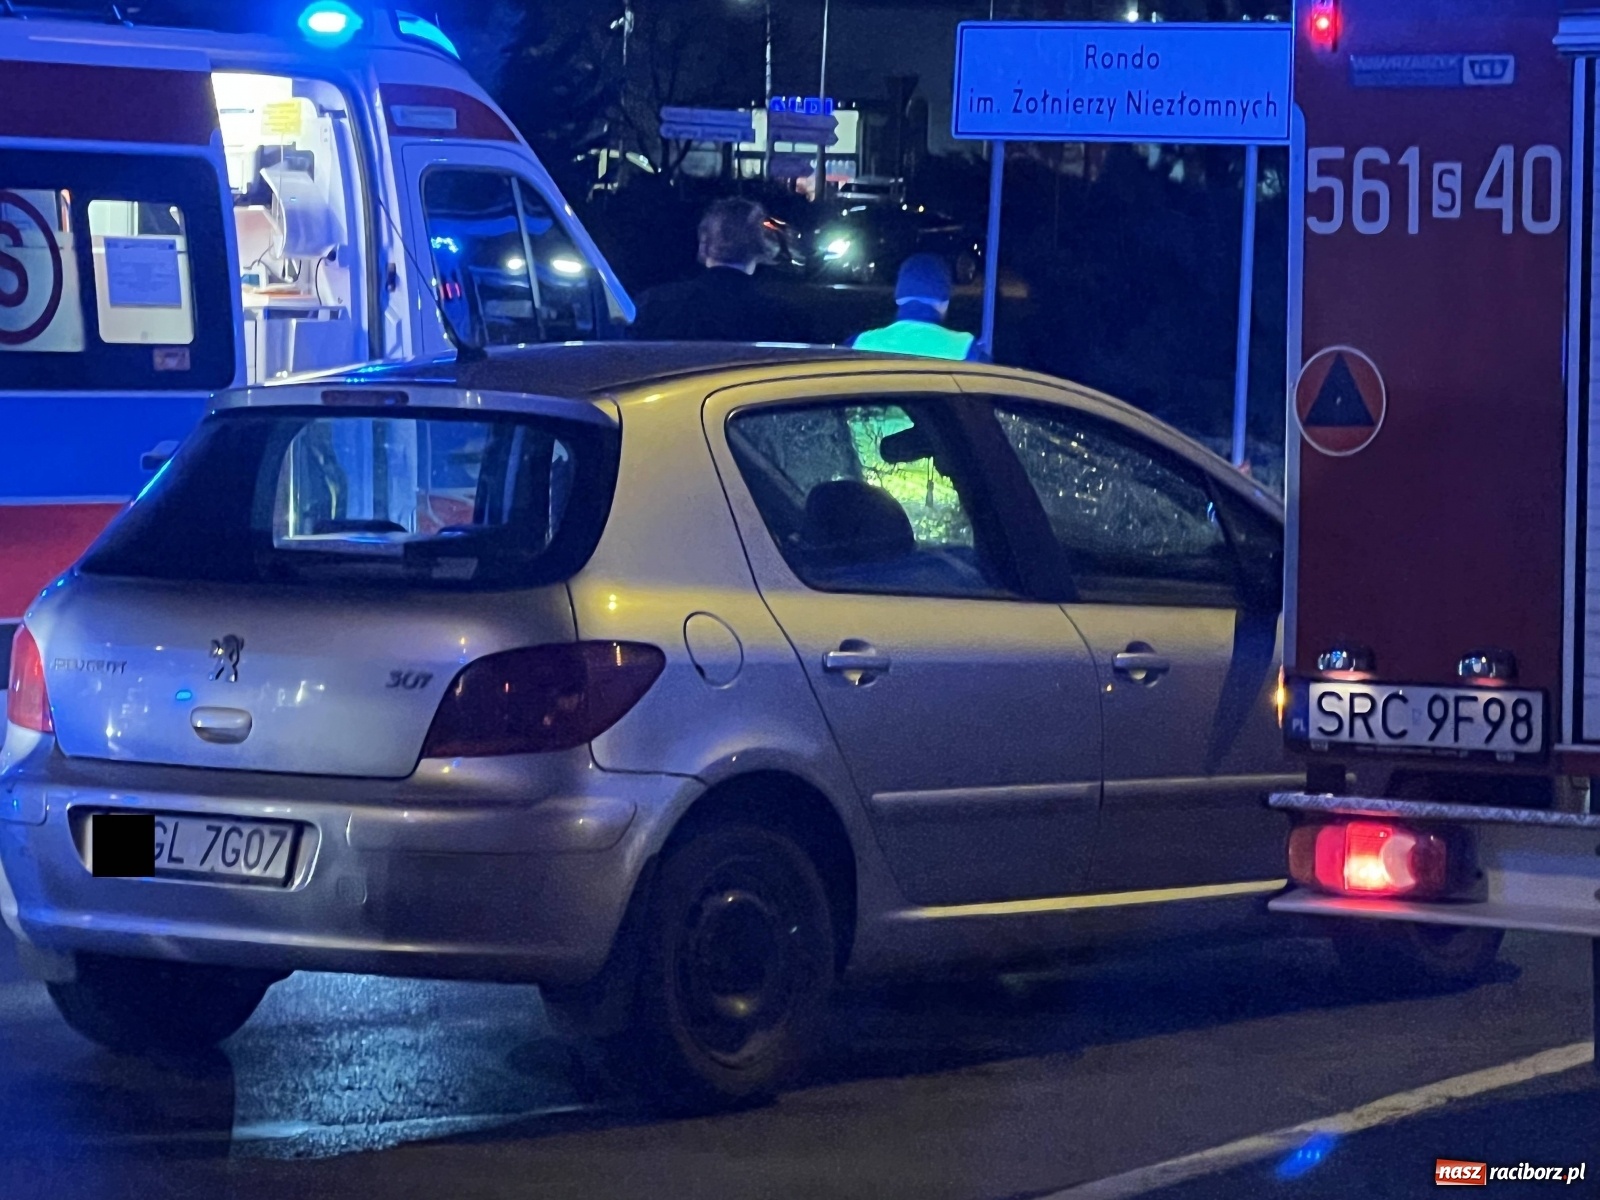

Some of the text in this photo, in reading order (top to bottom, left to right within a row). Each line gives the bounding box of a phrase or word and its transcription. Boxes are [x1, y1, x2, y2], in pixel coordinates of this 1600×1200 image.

[1084, 44, 1161, 70] Rondo
[968, 79, 1278, 125] im. Żołnierzy Niezłomnych
[1306, 144, 1562, 235] 561 S 40
[1292, 717, 1306, 732] PL
[1316, 690, 1534, 745] SRC 9F98
[155, 820, 288, 874] GL 7G07
